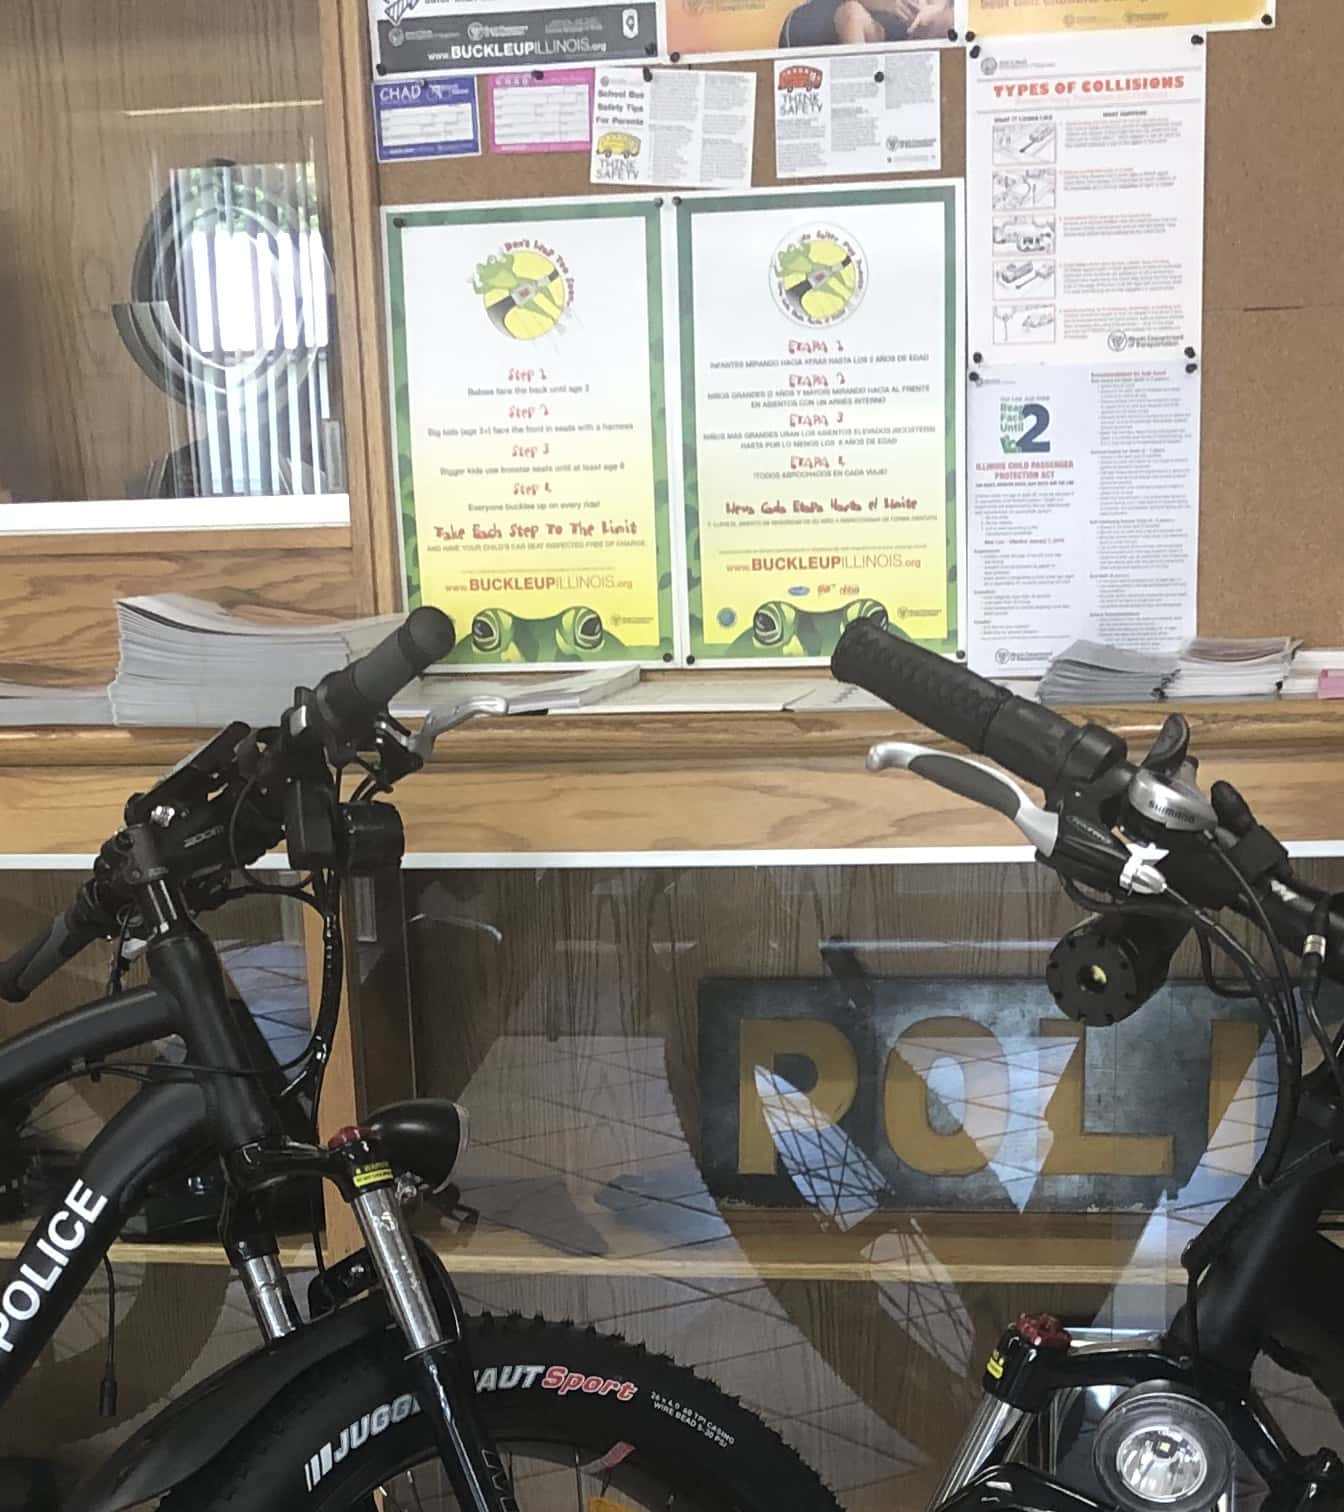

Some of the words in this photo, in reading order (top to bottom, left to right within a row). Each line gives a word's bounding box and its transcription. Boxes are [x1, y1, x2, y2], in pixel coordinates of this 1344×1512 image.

[426, 37, 607, 61] www.BUCKLEUPILLINOIS.org
[379, 87, 422, 102] CHAD
[597, 89, 626, 101] School
[629, 89, 645, 100] Bus
[992, 82, 1050, 99] TYPES
[1054, 81, 1077, 95] OF
[1081, 75, 1186, 94] COLLISIONS
[782, 94, 819, 104] THINK
[597, 102, 623, 114] Safety
[625, 103, 644, 114] Tips
[779, 102, 824, 116] SAFETY
[595, 115, 609, 125] For
[598, 158, 635, 170] THINK
[595, 167, 640, 180] SAFETY
[1000, 422, 1024, 433] Until
[1016, 402, 1051, 453] 2
[433, 525, 466, 541] Take
[472, 522, 503, 541] Each
[509, 522, 540, 540] Step
[545, 522, 564, 536] To
[569, 521, 594, 537] The
[601, 519, 639, 536] Limit
[726, 554, 922, 573] www.BUCKLEUPILLINOIS.org
[445, 575, 633, 593] www.BUCKLEUPILLINOIS.org
[333, 1364, 546, 1465] JUGGAUT
[541, 1364, 639, 1402] Sport
[653, 1401, 674, 1417] WIRE
[674, 1411, 698, 1430] BEAD
[692, 1409, 707, 1422] TPI
[706, 1416, 736, 1446] CASING
